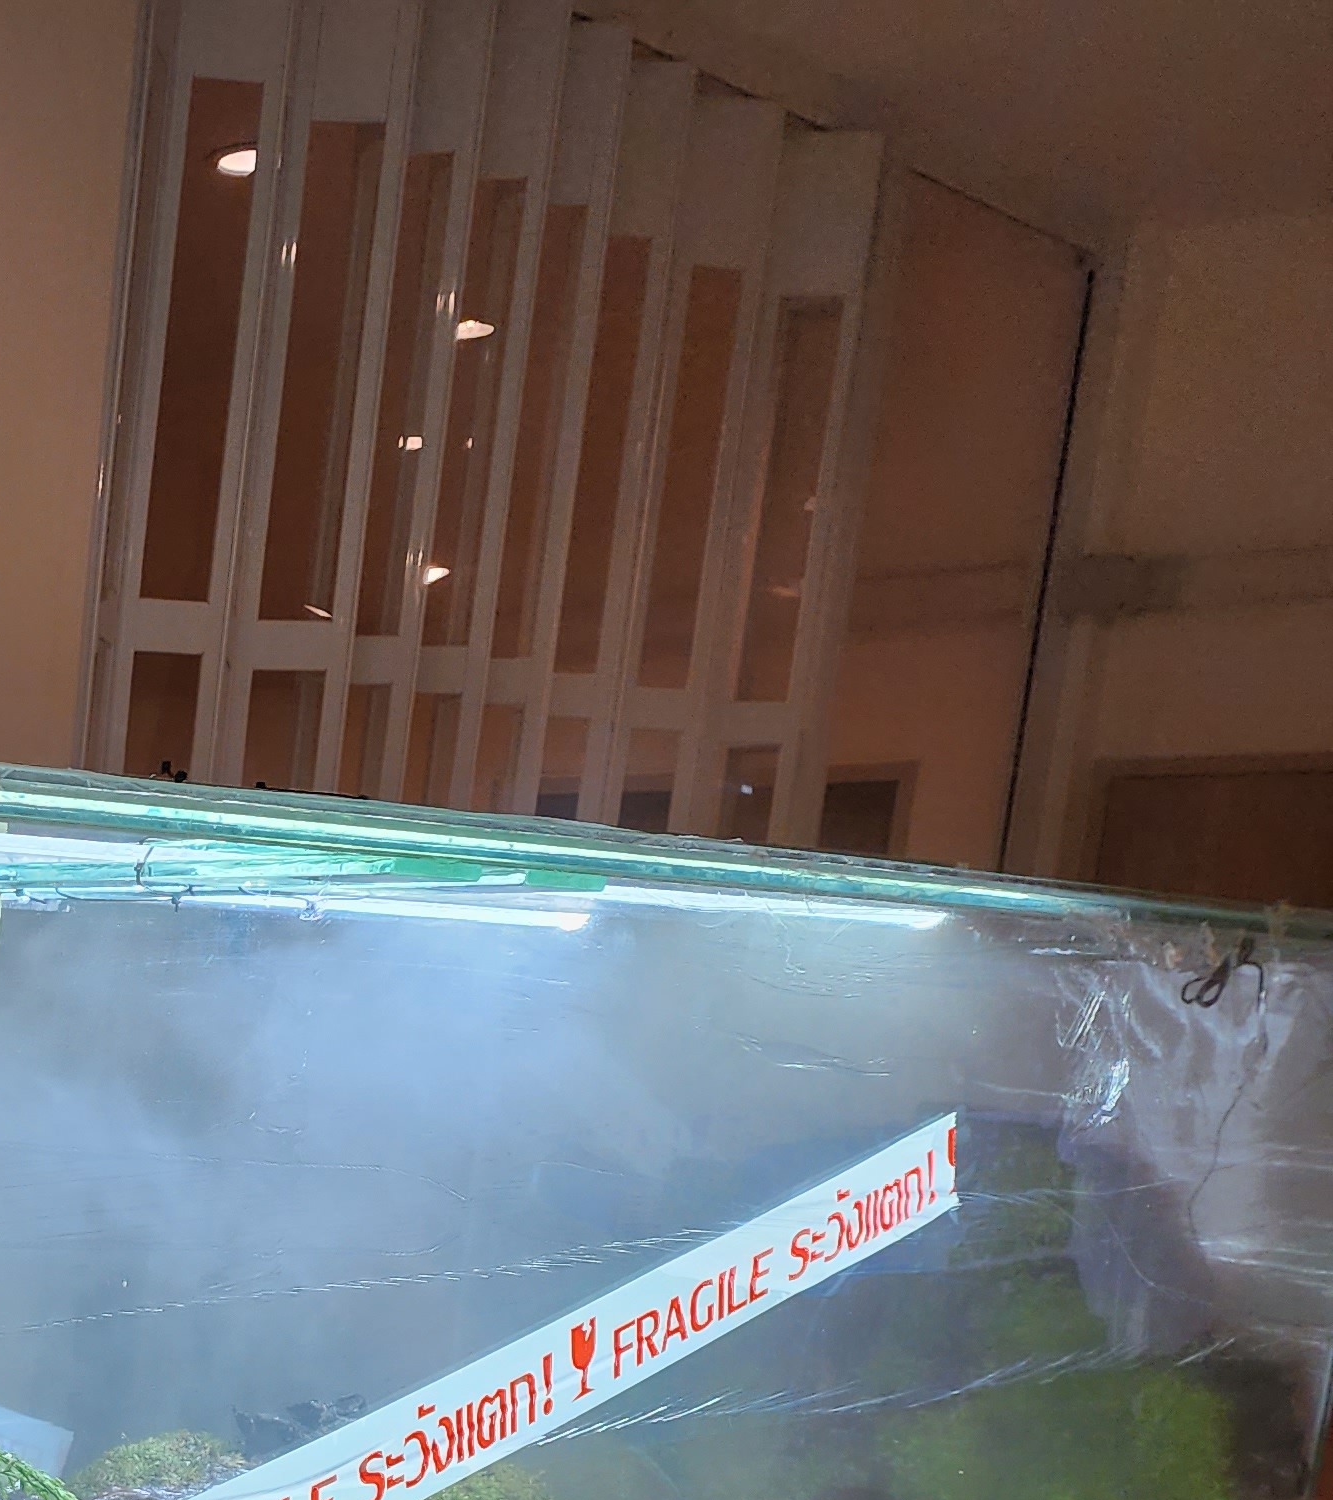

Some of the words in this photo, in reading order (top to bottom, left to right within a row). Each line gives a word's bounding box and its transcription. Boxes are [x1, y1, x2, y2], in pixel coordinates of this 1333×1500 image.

[613, 1247, 773, 1377] FRAGILE
[788, 1150, 937, 1281] ระวังแตก!
